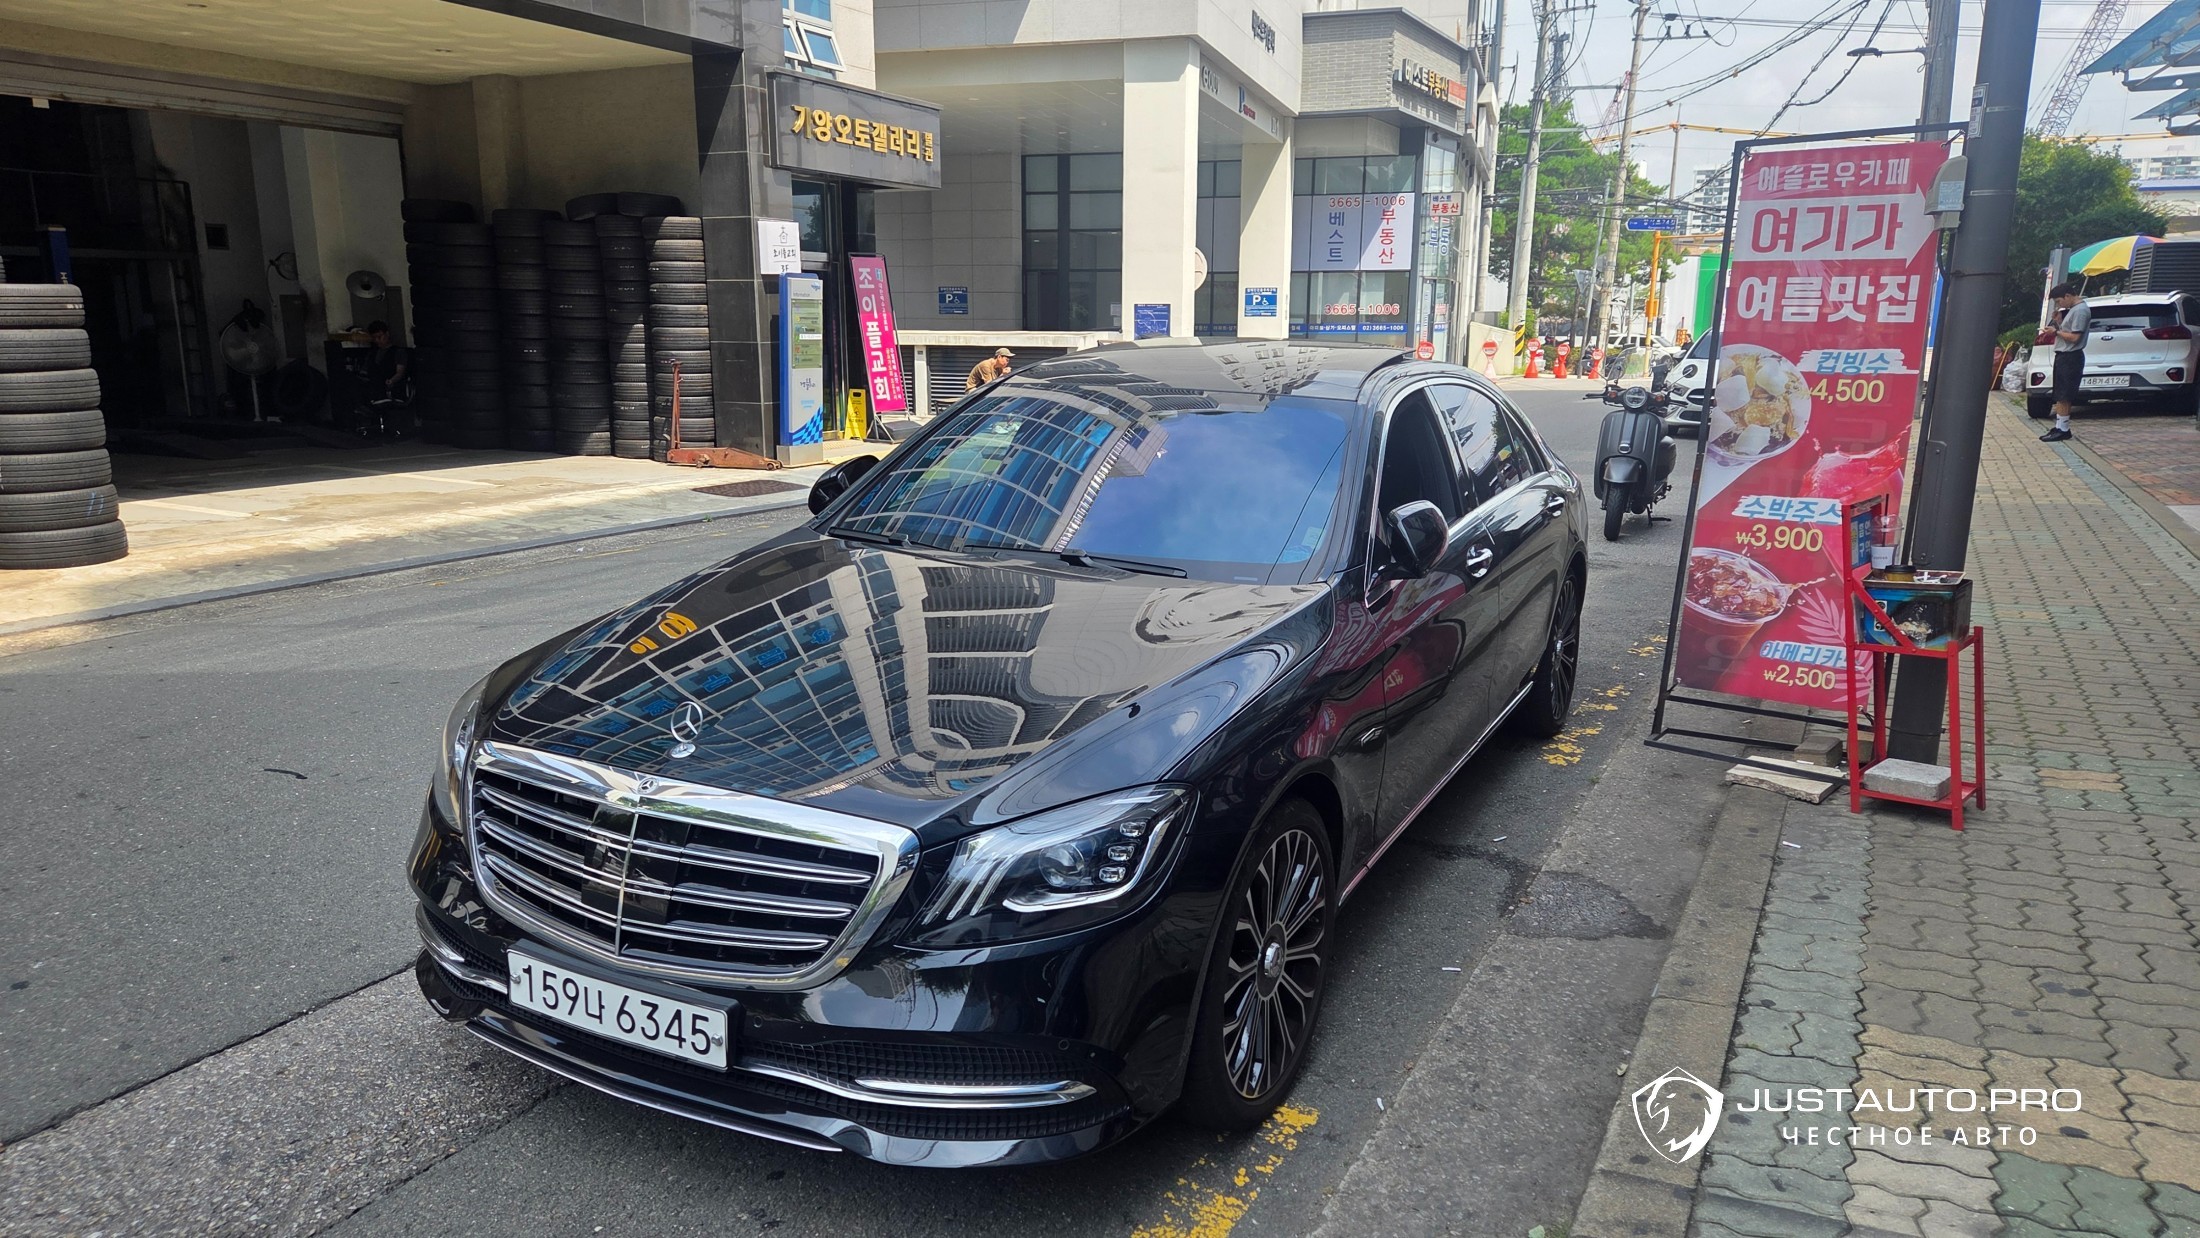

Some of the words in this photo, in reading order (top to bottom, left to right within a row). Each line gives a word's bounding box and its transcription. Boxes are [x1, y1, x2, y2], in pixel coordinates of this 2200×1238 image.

[791, 104, 920, 159] 기양오토갤러리
[1758, 158, 1910, 192] 에슬로우카페
[1329, 196, 1405, 208] 3665-1006
[1431, 202, 1459, 214] 부동산
[1327, 211, 1345, 262] 베스트
[1378, 208, 1396, 265] 부동산
[1750, 203, 1904, 253] 여기가
[945, 293, 953, 304] P
[1252, 295, 1261, 306] P
[1324, 303, 1400, 316] 3665-1006
[1736, 274, 1921, 323] 여름맛집
[858, 268, 891, 401] 조이플교회
[1816, 351, 1891, 375] 컵빙수
[1743, 498, 1841, 524] 수박주스
[1760, 641, 1849, 667] 아메리카
[522, 964, 606, 1025] 159나
[616, 994, 711, 1056] 6345
